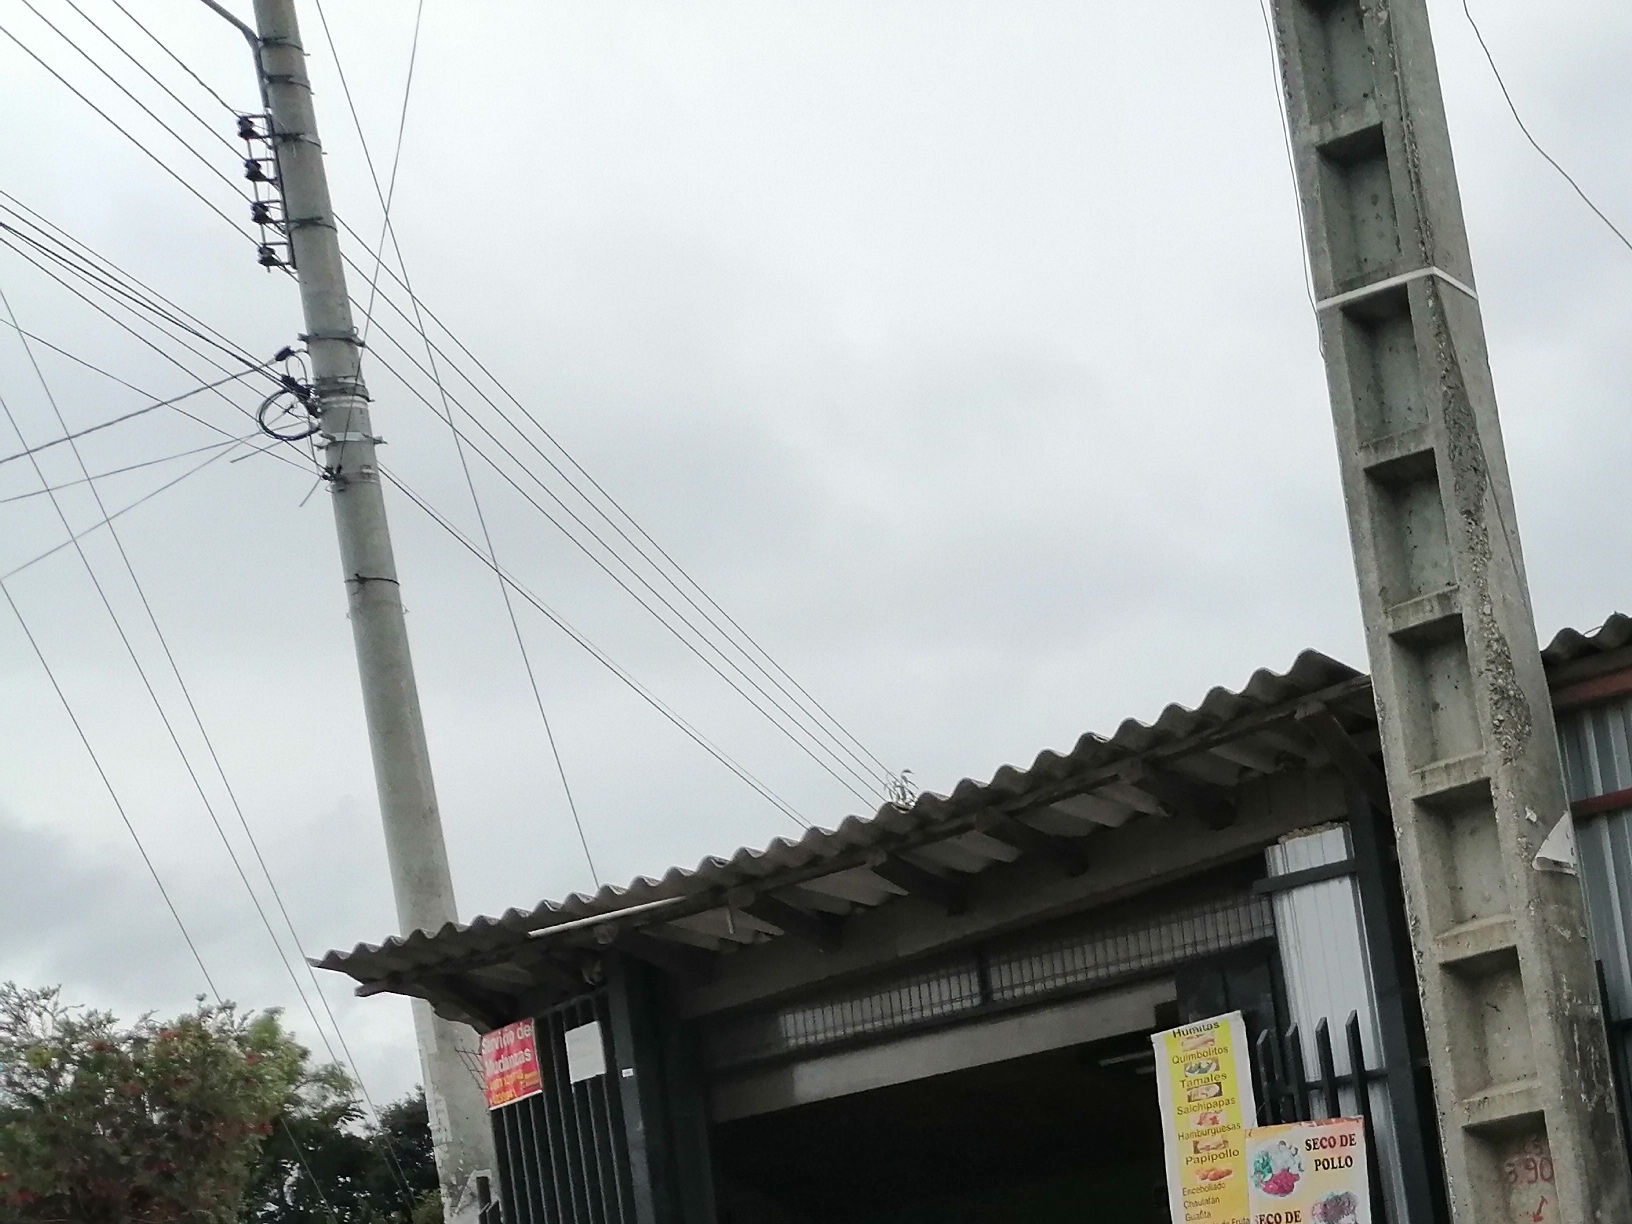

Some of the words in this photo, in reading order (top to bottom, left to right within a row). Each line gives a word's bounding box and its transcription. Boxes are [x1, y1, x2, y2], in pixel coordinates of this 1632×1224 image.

[517, 1022, 531, 1039] de
[1172, 1022, 1220, 1038] Humitas
[1172, 1046, 1229, 1064] Quimbolitos
[1180, 1073, 1227, 1088] Tamales
[1177, 1098, 1236, 1115] Salchipapas
[1178, 1123, 1241, 1140] Hamburguesas
[1305, 1136, 1336, 1151] SECO
[1340, 1133, 1357, 1147] DE
[1185, 1149, 1240, 1165] Papipollo
[1314, 1156, 1353, 1171] POLLO
[1182, 1182, 1226, 1196] Encebollado
[1285, 1210, 1302, 1224] DE
